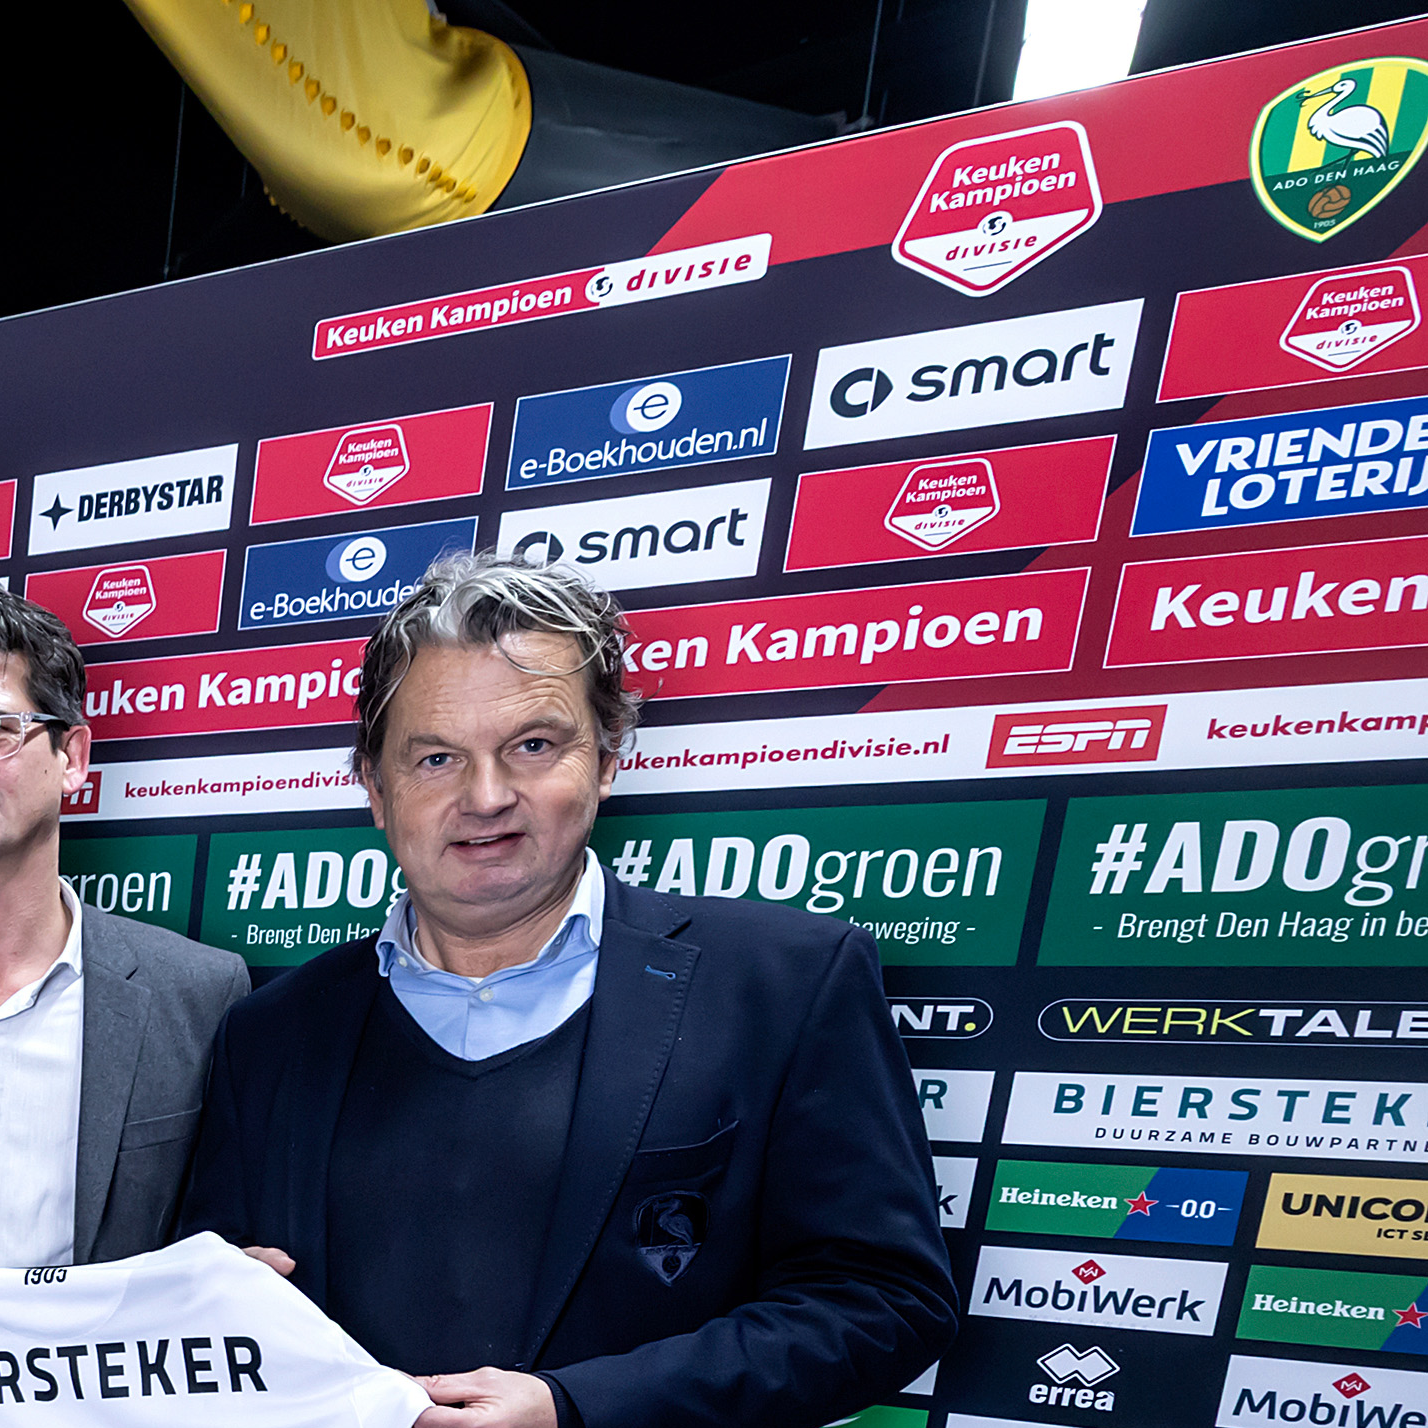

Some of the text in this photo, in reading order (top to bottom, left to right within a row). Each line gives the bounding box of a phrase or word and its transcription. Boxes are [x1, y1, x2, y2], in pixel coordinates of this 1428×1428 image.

[951, 152, 1061, 189] Keuken
[1273, 160, 1400, 191] ADO DEN HAAG
[929, 170, 1077, 214] Kampioen
[945, 234, 1038, 262] divisie
[326, 251, 753, 349] Keuken Kampioen divisie
[1305, 295, 1404, 320] Kampioen
[1321, 284, 1394, 306] Keuken
[1316, 333, 1378, 351] divisie
[906, 332, 1114, 405] smart
[338, 447, 399, 464] Kampioen
[347, 438, 392, 454] Keuken
[519, 417, 768, 481] e-Boekhouden.nl
[905, 484, 987, 504] Kampioen
[918, 474, 978, 491] Keuken
[77, 474, 224, 522] DERBYSTAR
[575, 507, 749, 564] smart
[914, 518, 965, 531] divisie
[94, 584, 147, 601] Kampioen
[102, 576, 141, 590] Keuken
[1150, 571, 1428, 631] Keuken
[725, 603, 1044, 667] Kampioen
[1002, 719, 1154, 756] ESPN
[611, 832, 1003, 914] #ADOgroen
[246, 923, 303, 948] Brengt
[308, 924, 341, 944] Den
[1117, 913, 1209, 944] Brengt
[1215, 911, 1270, 938] Den
[1277, 910, 1354, 942] Haag
[1360, 912, 1387, 938] in
[1052, 1082, 1428, 1128] BIERSTEK
[1094, 1127, 1233, 1146] DUURZAME
[999, 1186, 1118, 1211] Heineken
[1280, 1192, 1428, 1223] UNICO
[1376, 1227, 1409, 1242] ICT
[982, 1277, 1207, 1323] MobiWerk
[1251, 1293, 1385, 1321] Heineken
